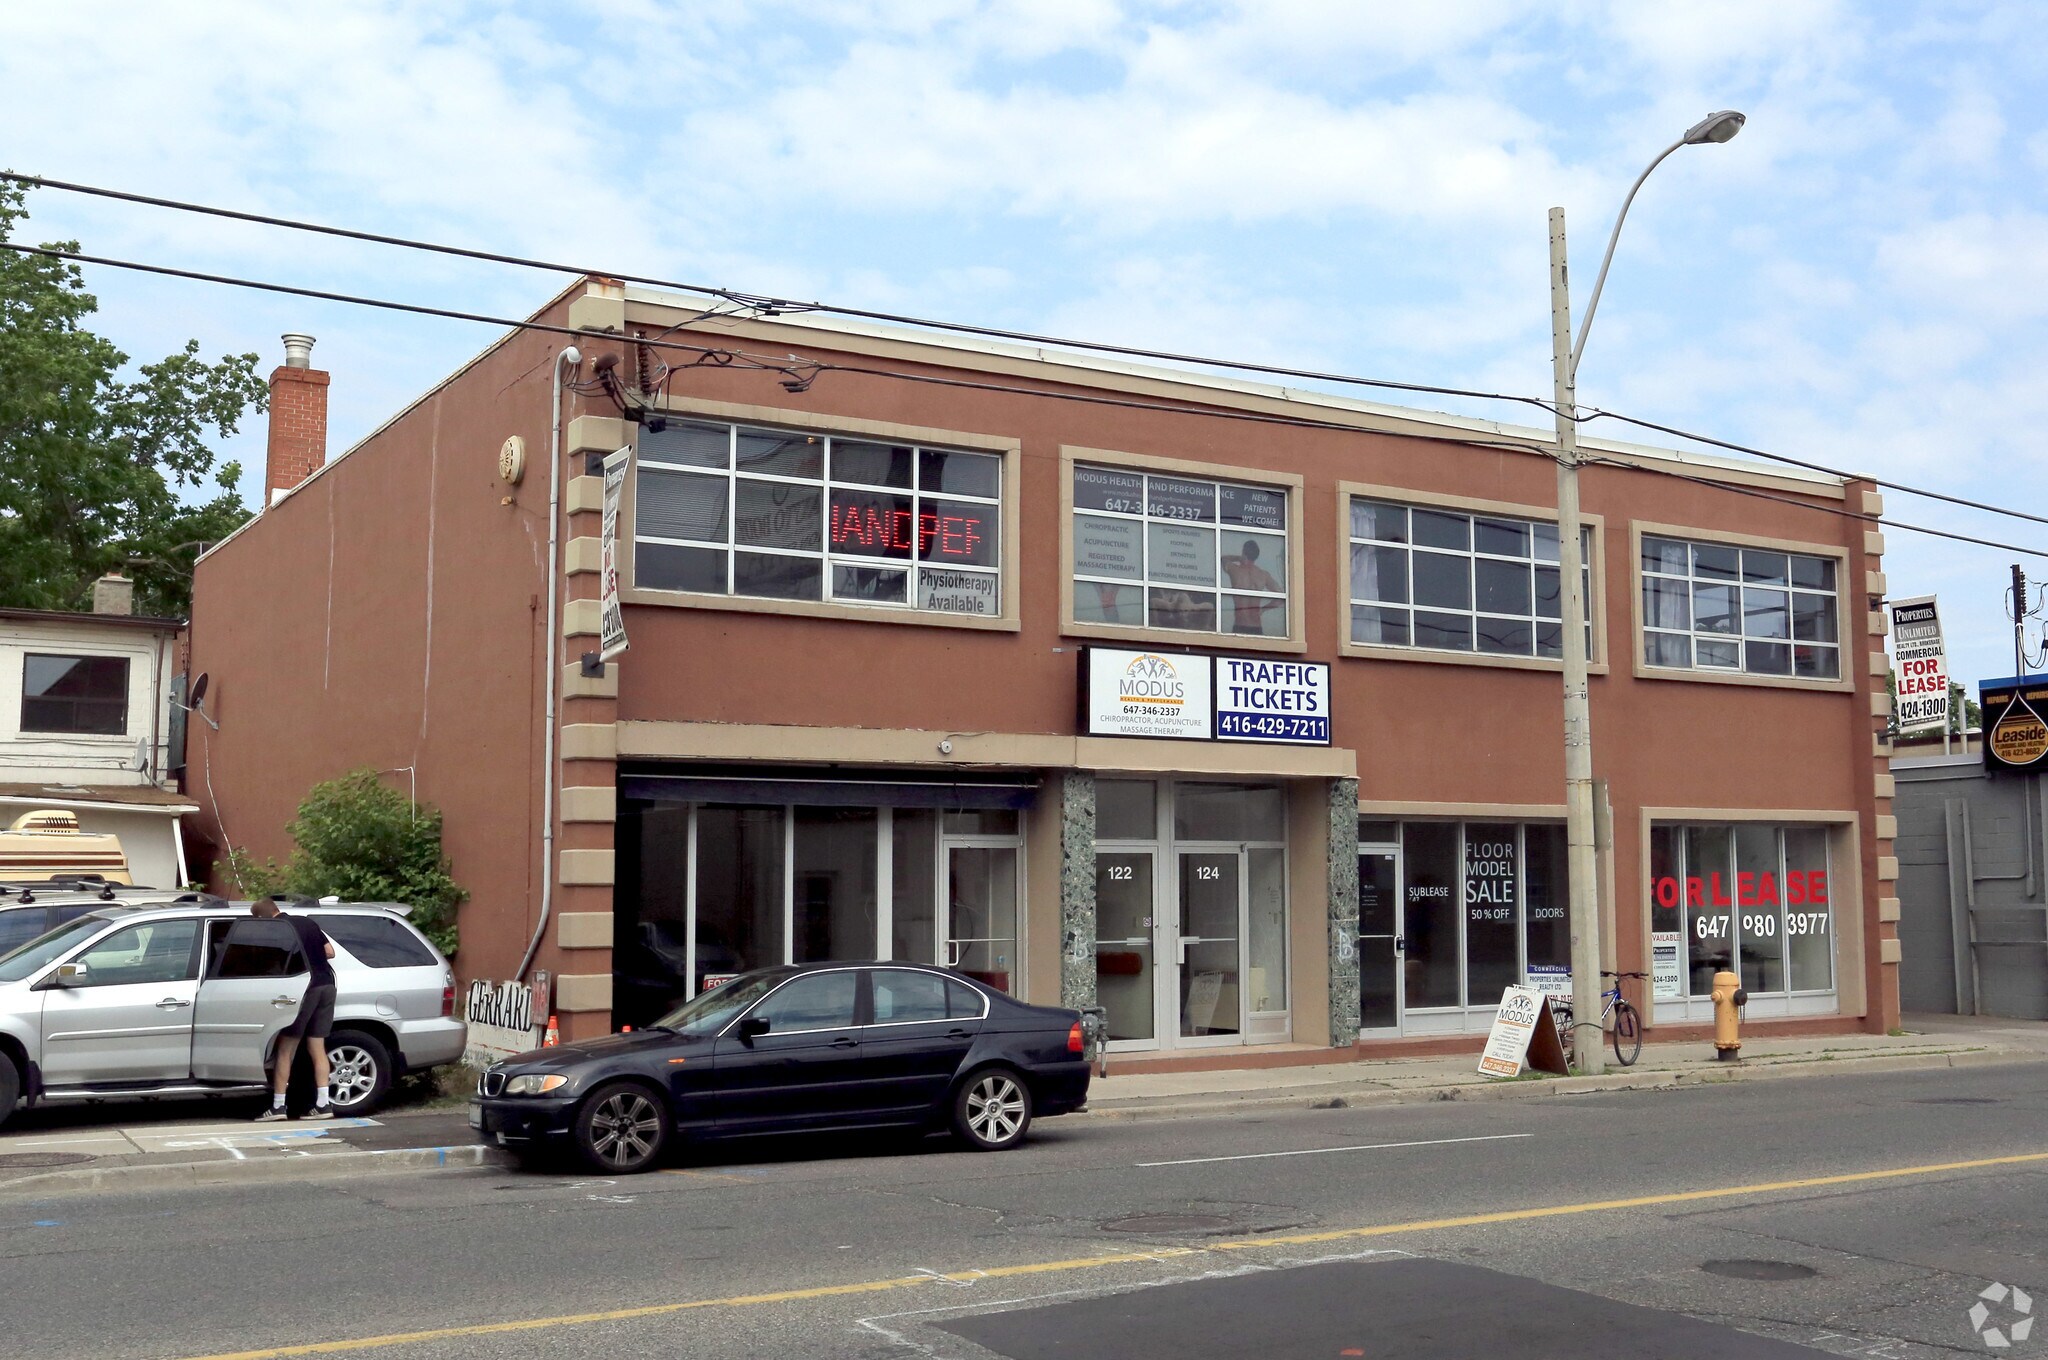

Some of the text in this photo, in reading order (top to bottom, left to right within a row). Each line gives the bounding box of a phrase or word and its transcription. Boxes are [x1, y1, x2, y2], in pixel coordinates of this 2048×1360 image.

[1075, 472, 1235, 500] MODUS HEALTH AND PERFORMANCE
[1252, 493, 1269, 502] NEW
[1105, 498, 1201, 520] 647-346-2337
[1244, 504, 1277, 515] PATIENTS
[1084, 522, 1129, 534] CHIROPRACTIC
[1083, 538, 1129, 549] ACUPUNCTURE
[1088, 552, 1126, 562] REGISTERED
[1077, 561, 1136, 573] MASSAGE THERAPY
[921, 570, 994, 595] Physiotherapy
[928, 594, 984, 613] Available
[1896, 646, 1944, 661] COMMERCIAL
[1227, 660, 1318, 687] TRAFFIC
[1903, 658, 1938, 676] FOR
[1120, 679, 1184, 698] MODUS
[1898, 675, 1946, 696] LEASE
[1229, 686, 1318, 712] TICKETS
[1123, 705, 1181, 717] 647-346-2337
[1900, 697, 1946, 719] 424-1300
[1154, 717, 1202, 727] ACUPUNCTURE
[1221, 715, 1325, 737] 416-429-7211
[1120, 726, 1184, 736] MASSAGE THERAPY
[1994, 726, 2046, 743] Leaside
[1465, 843, 1514, 858] FLOOR
[1107, 866, 1133, 880] 122
[1196, 866, 1220, 880] 124
[1466, 861, 1514, 876] MODEL
[1408, 886, 1449, 897] SUBLEASE
[1465, 880, 1514, 903] SALE
[1711, 870, 1828, 907] LEASE
[1493, 908, 1510, 919] OFF
[1535, 908, 1565, 918] DOORS
[1696, 915, 1730, 938] 647
[1787, 913, 1828, 935] 3977
[1498, 1008, 1535, 1024] MODUS
